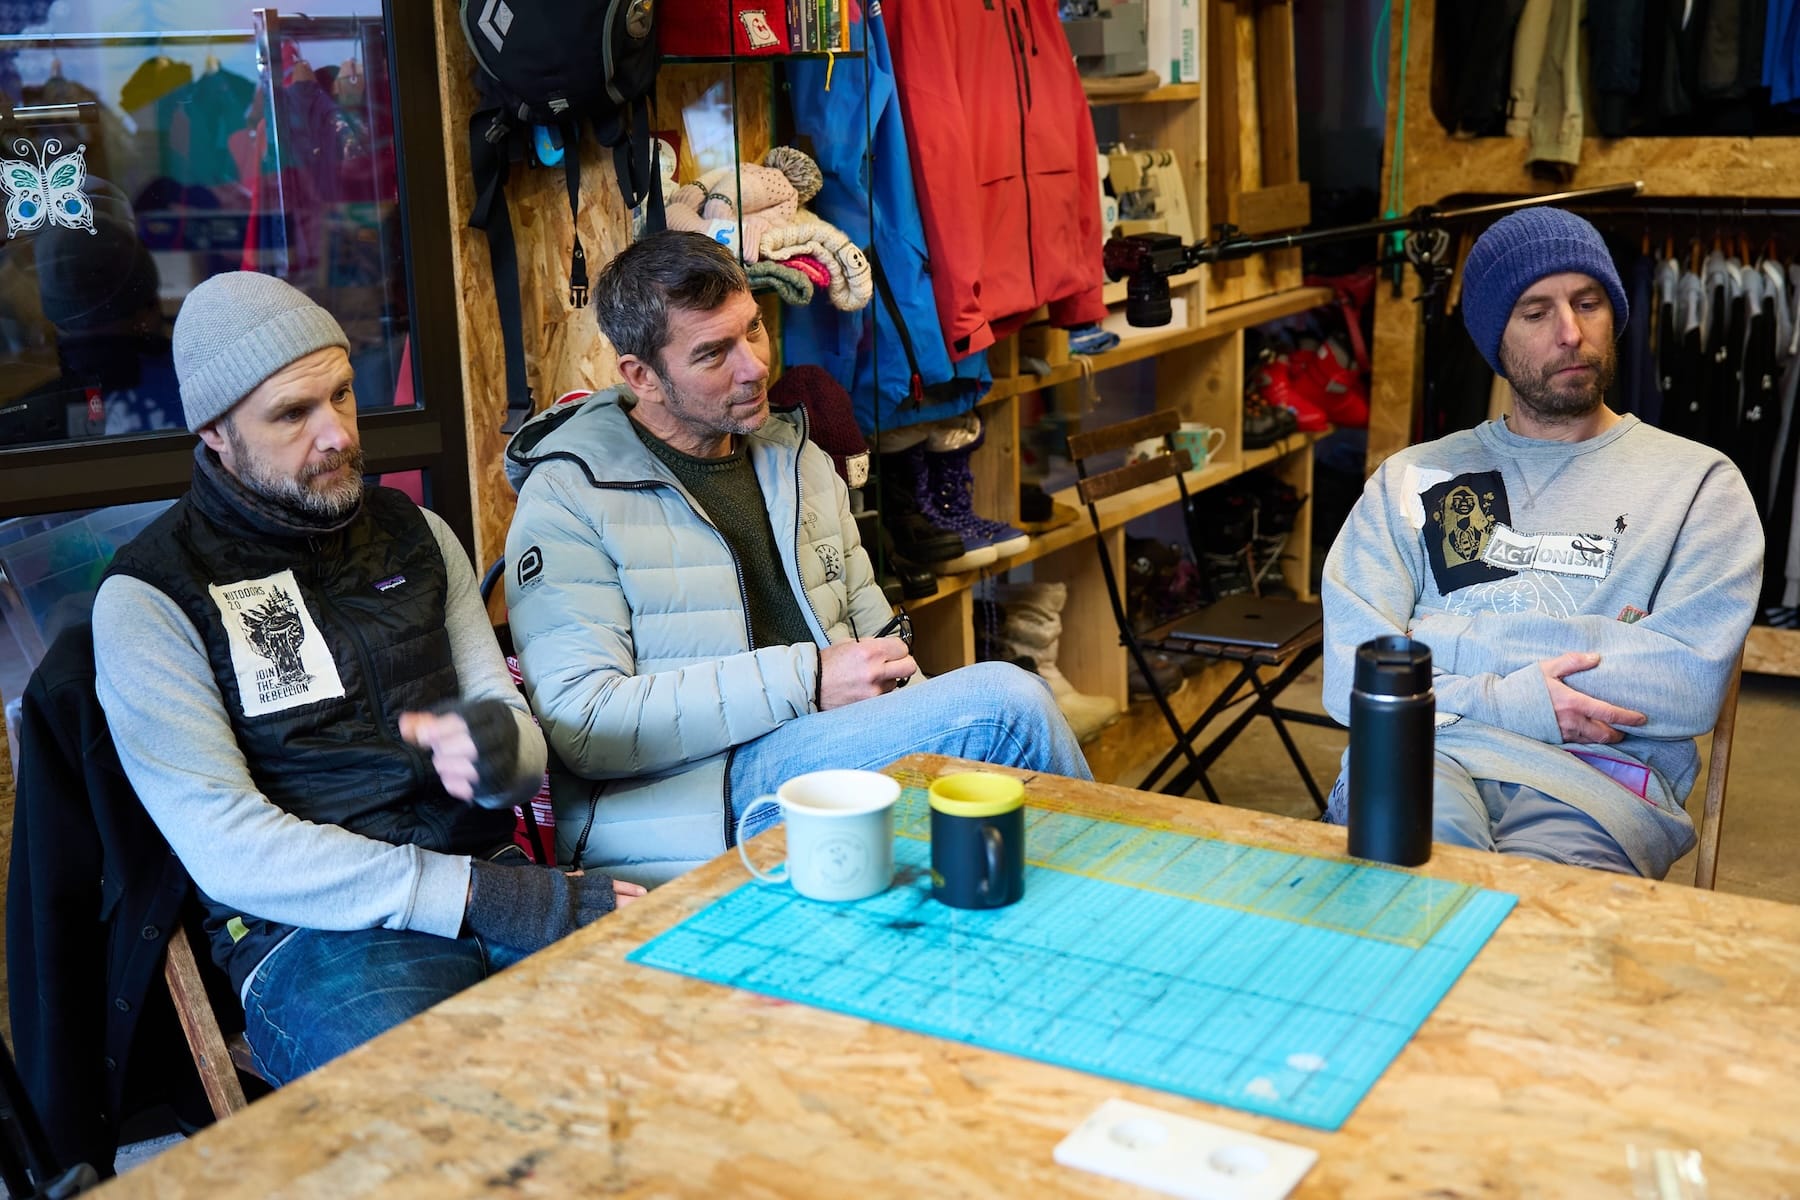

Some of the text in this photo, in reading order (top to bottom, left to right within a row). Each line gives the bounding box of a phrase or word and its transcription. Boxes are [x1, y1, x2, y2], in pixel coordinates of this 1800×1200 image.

[223, 586, 266, 601] OUTDOORS
[255, 667, 275, 681] JOIN
[257, 679, 275, 693] THE
[259, 683, 309, 703] REBELLION
